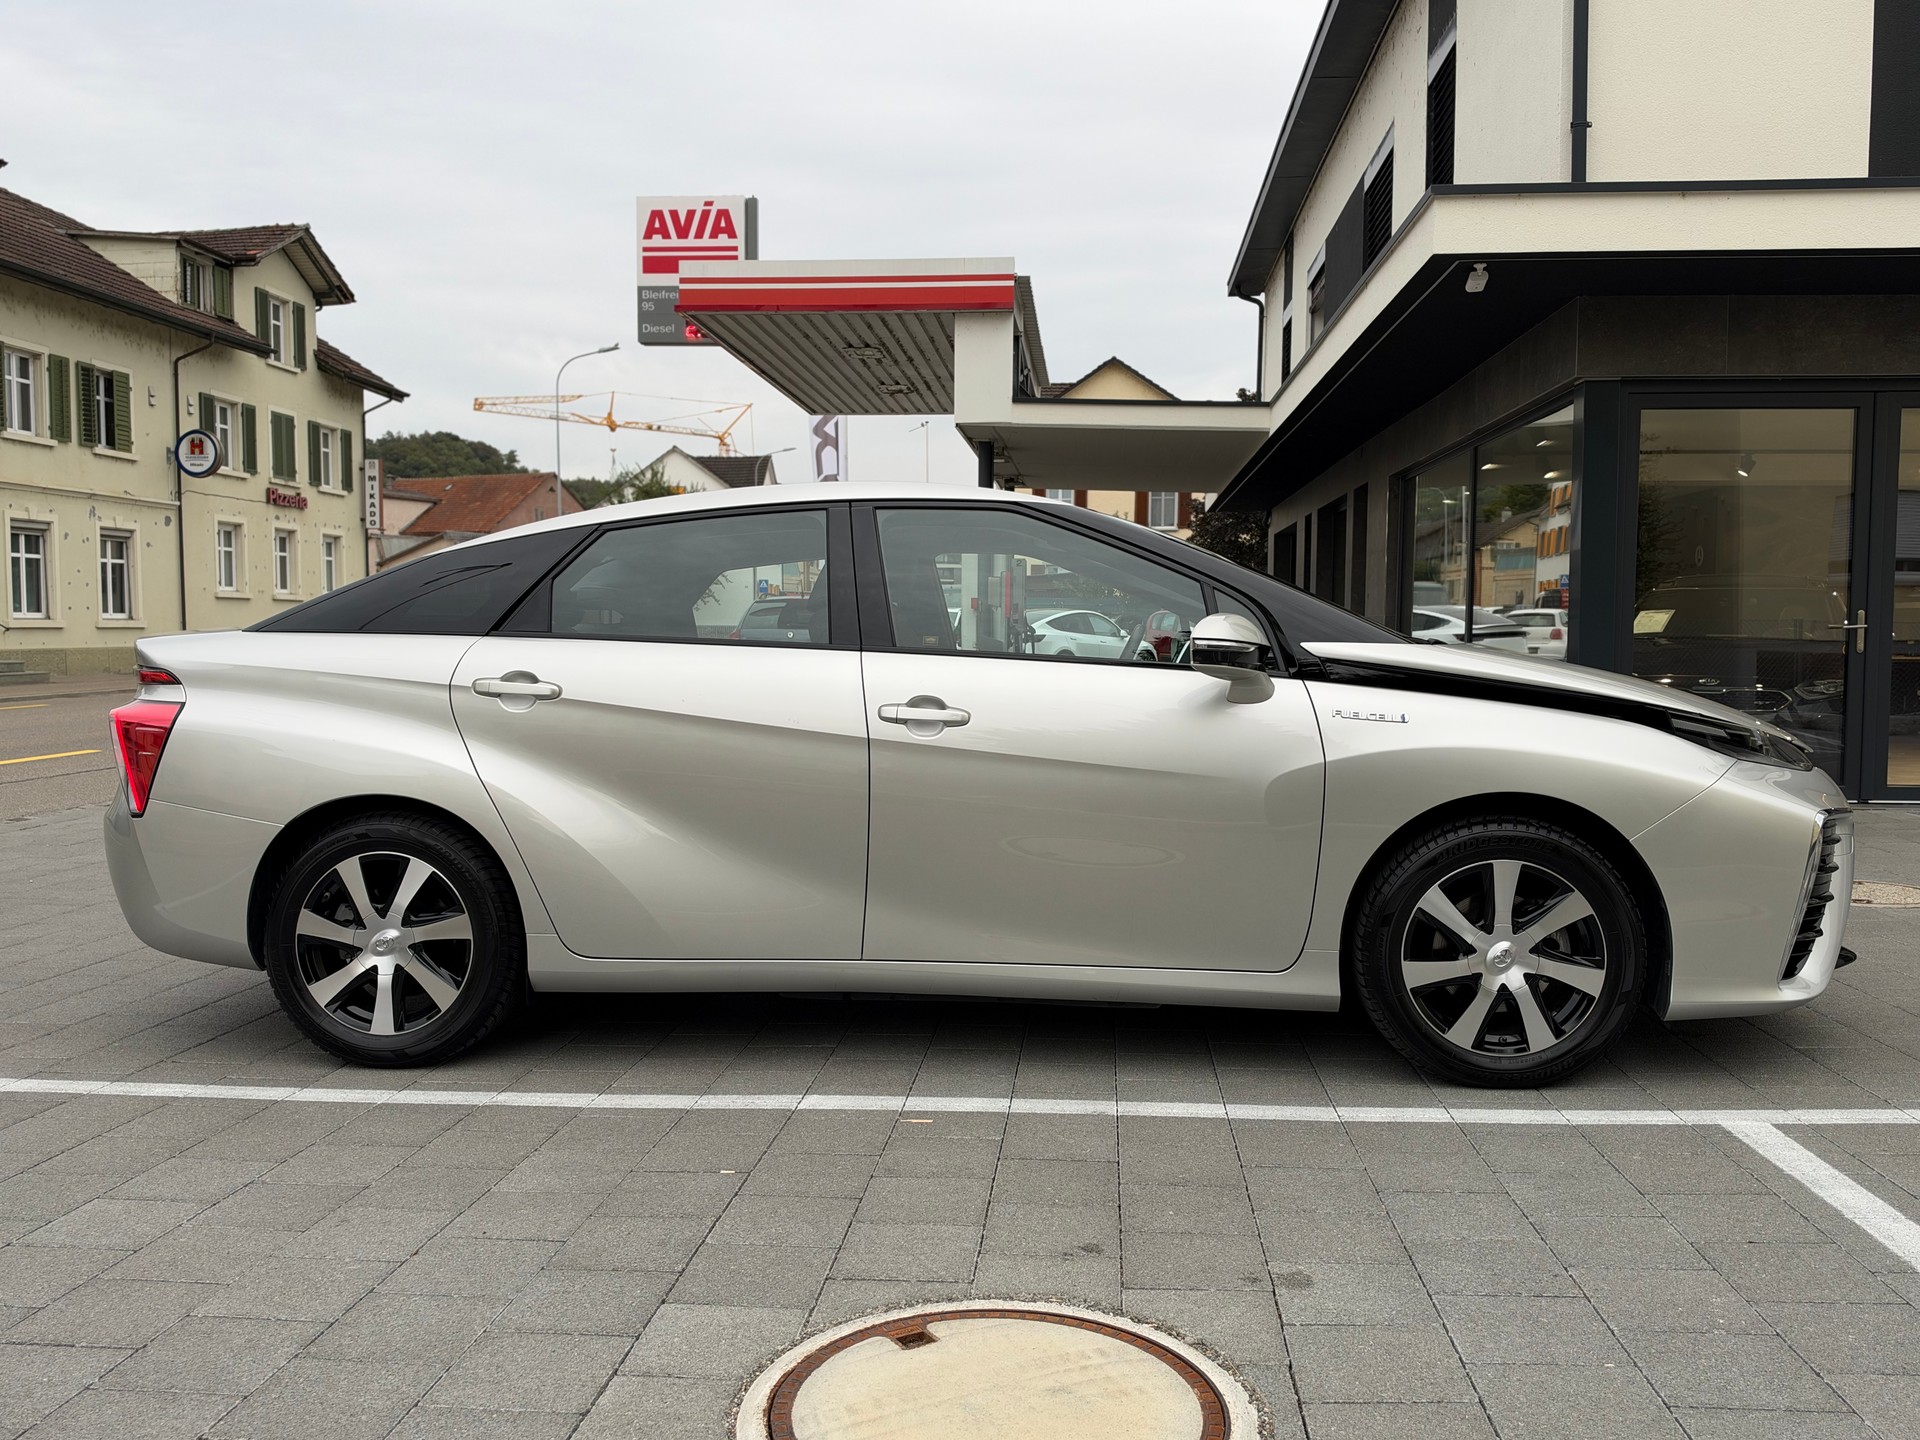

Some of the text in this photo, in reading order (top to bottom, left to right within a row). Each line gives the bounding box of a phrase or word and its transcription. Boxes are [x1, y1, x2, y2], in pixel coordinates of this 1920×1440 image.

[641, 301, 655, 311] 95
[642, 323, 675, 334] Diesel
[268, 487, 309, 511] Pizzeria
[367, 475, 377, 527] MIKADO
